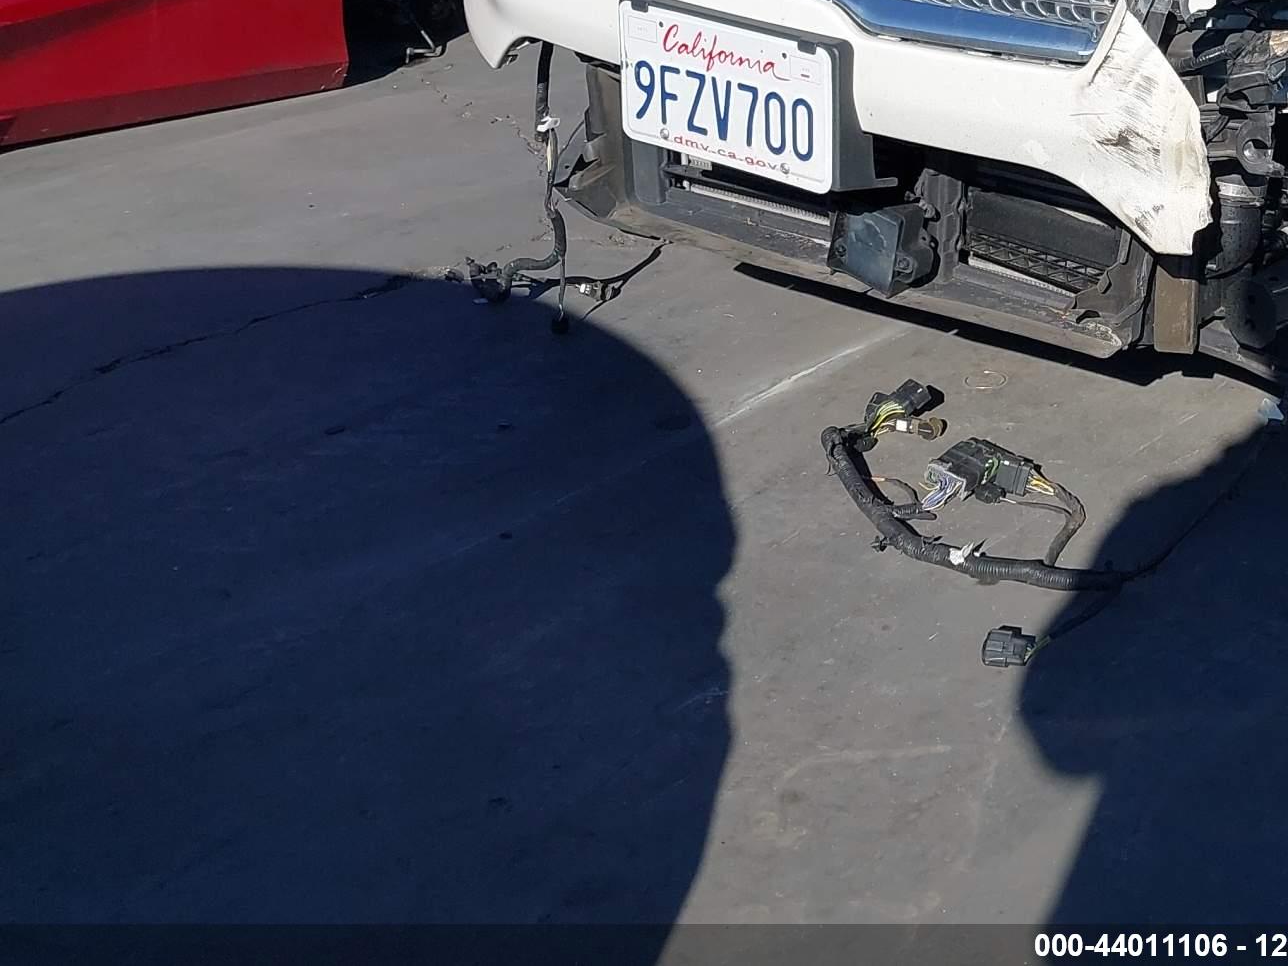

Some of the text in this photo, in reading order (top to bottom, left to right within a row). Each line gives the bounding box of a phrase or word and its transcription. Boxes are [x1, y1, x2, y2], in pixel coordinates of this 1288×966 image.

[662, 23, 792, 82] California
[634, 59, 814, 162] 9FZV700
[673, 135, 778, 172] dmv.ca.gov
